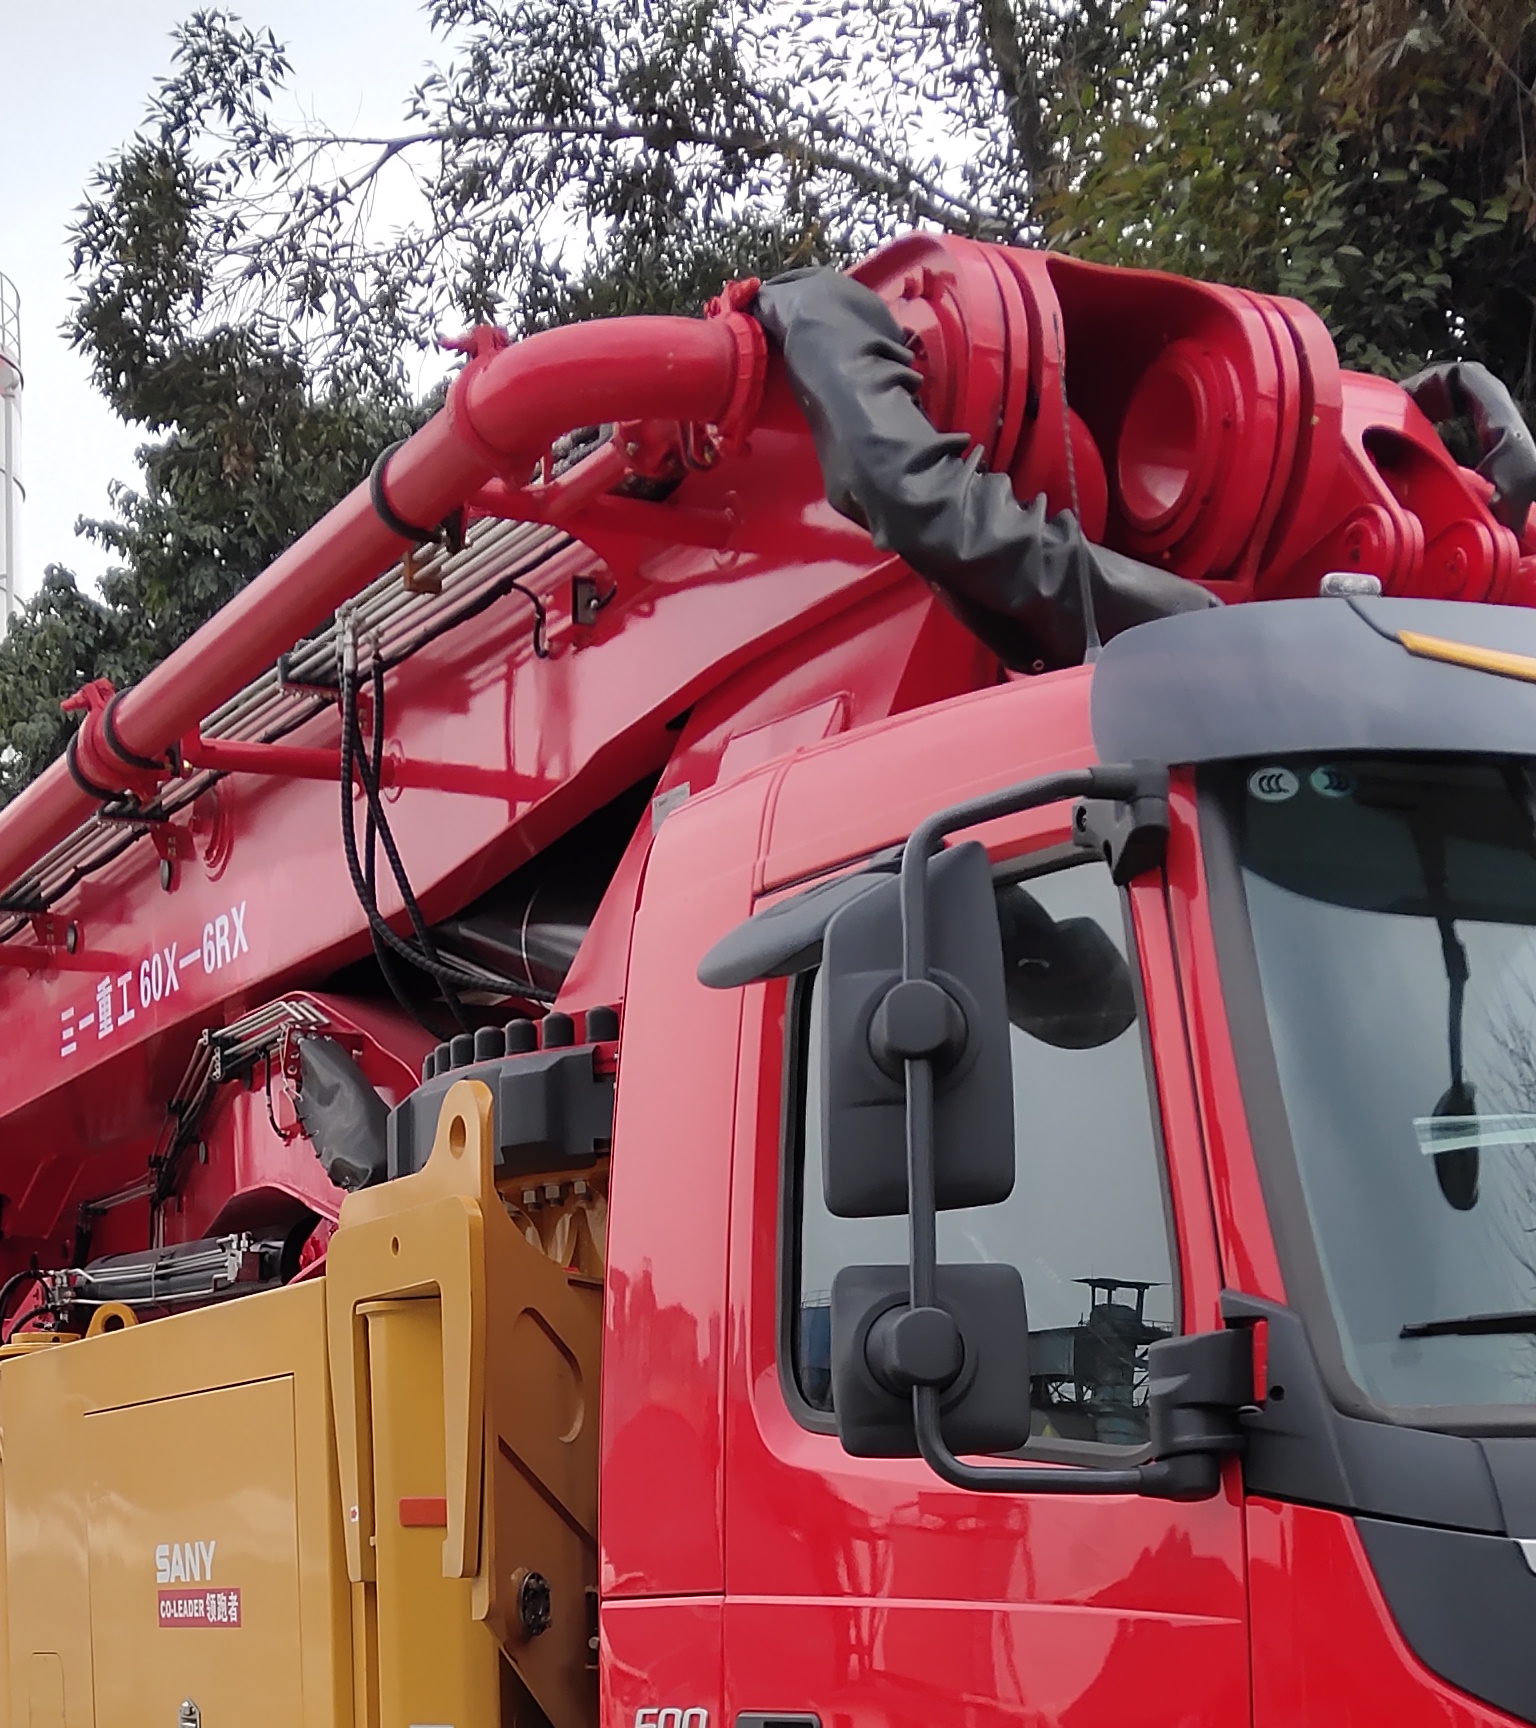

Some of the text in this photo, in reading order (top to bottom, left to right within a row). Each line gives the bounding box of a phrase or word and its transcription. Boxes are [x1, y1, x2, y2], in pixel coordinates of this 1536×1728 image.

[155, 1540, 217, 1584] SANY
[160, 1591, 239, 1623] CO-LEADER 领跑者
